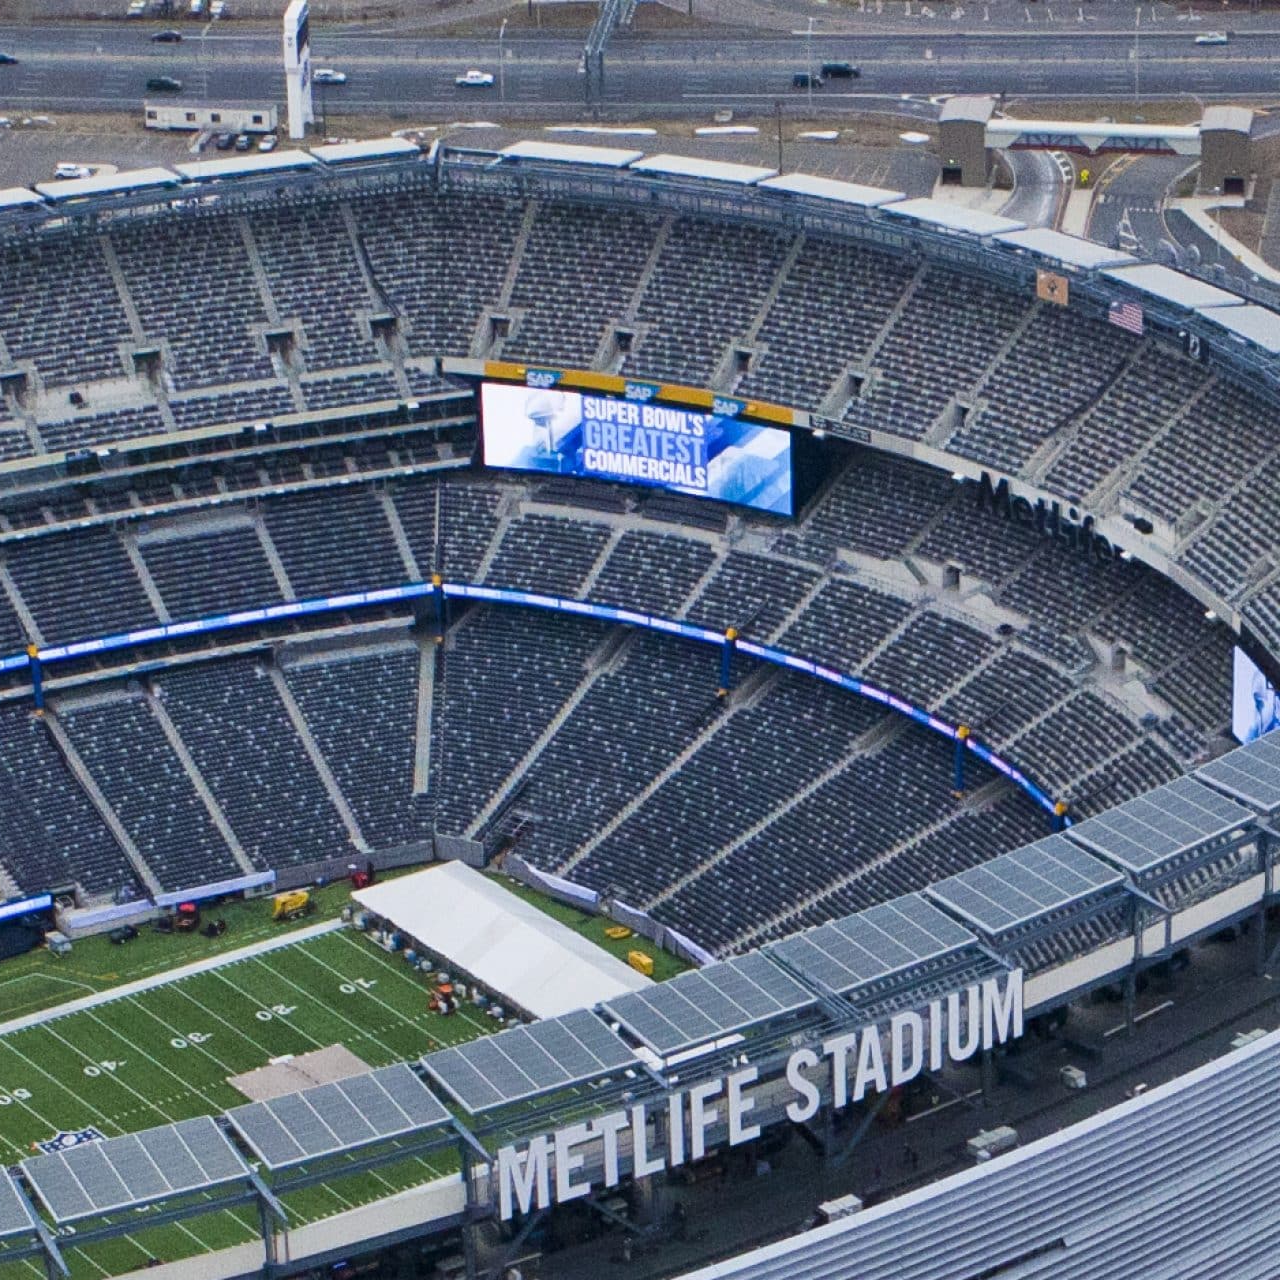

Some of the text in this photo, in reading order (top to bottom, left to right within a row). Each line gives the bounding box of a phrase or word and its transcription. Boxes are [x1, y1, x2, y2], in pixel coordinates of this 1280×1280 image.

[527, 371, 556, 388] SAP
[625, 384, 653, 401] SAP
[713, 399, 739, 417] SAP
[584, 397, 705, 437] SUPER BOWL'S
[584, 420, 705, 466] GREATEST
[583, 449, 707, 489] COMMERCIALS
[978, 471, 1114, 564] MetLife
[339, 978, 371, 994] 10
[256, 1004, 291, 1021] 20
[171, 1032, 207, 1049] 30
[83, 1060, 118, 1077] 40
[498, 968, 1023, 1222] METLIFE STADIUM
